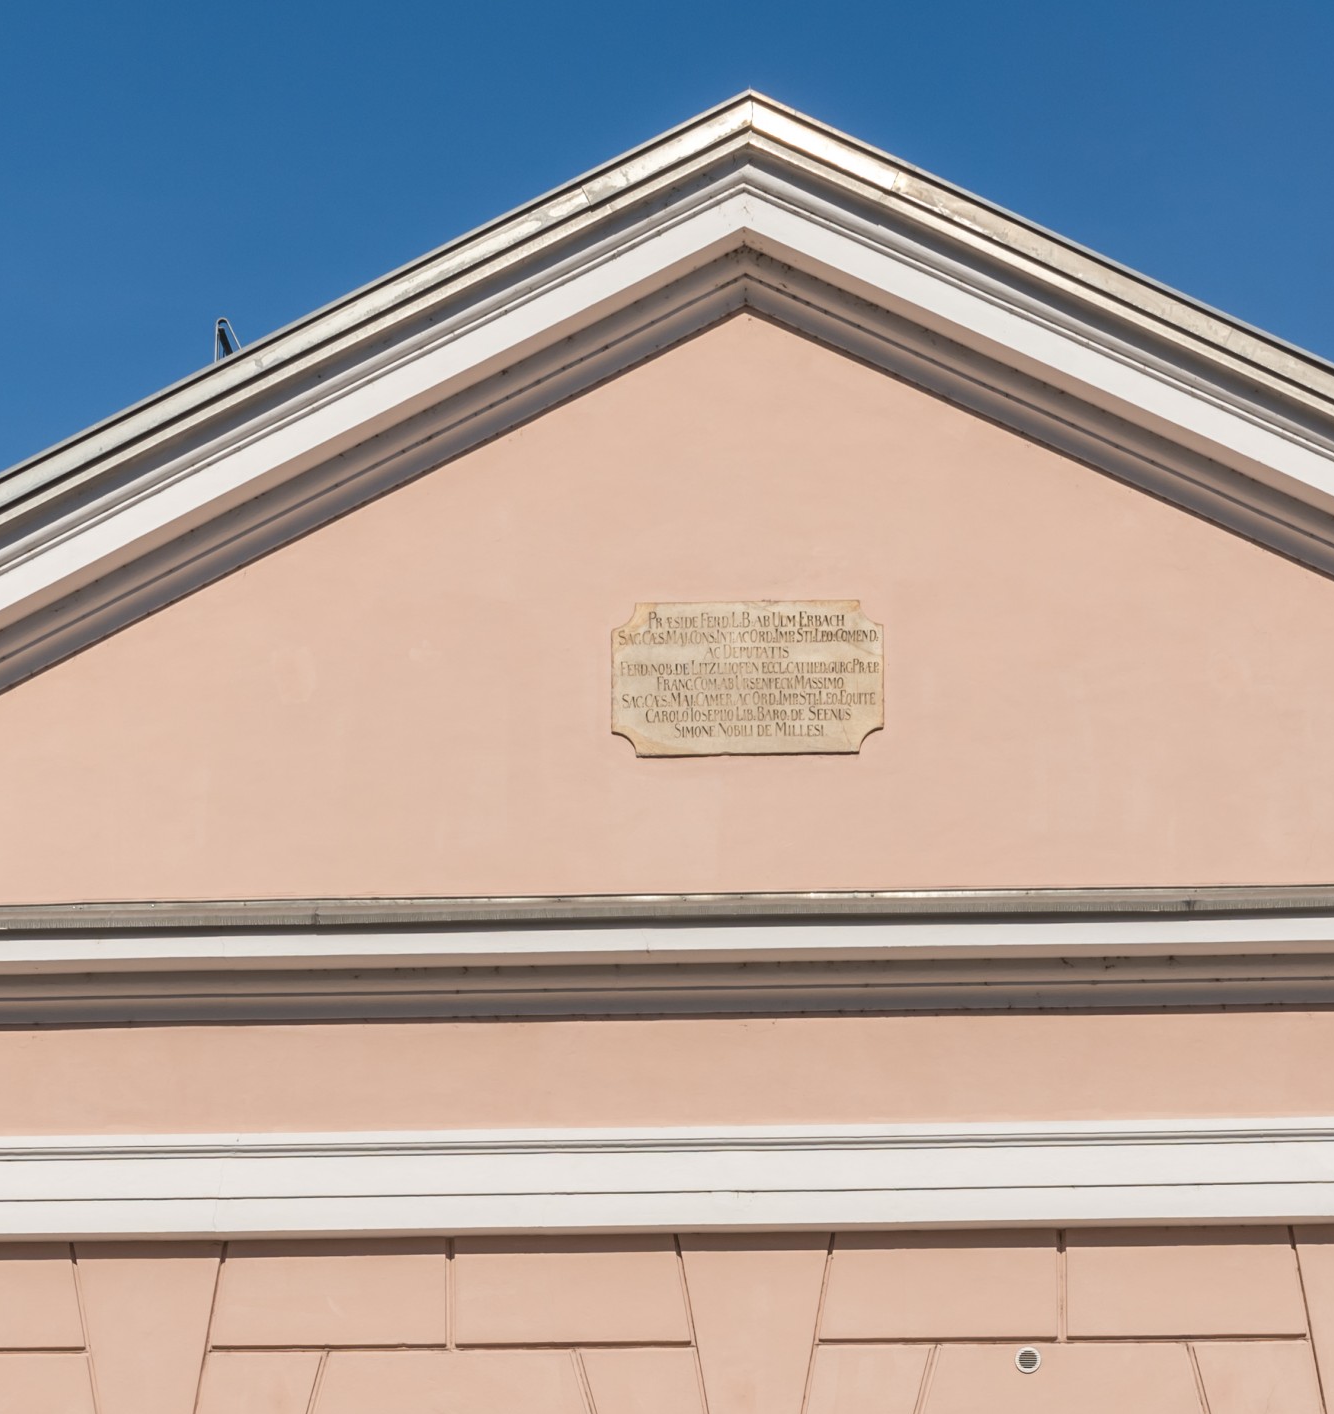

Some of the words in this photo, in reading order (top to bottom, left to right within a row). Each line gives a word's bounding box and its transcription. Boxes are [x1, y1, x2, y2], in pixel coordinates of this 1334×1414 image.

[772, 611, 795, 628] ULM
[799, 610, 844, 628] ERBACH
[723, 644, 789, 659] DEPUTATIS
[794, 674, 844, 690] MASSIMO
[645, 708, 689, 723] CAROLO
[674, 723, 716, 738] SIMONE
[717, 722, 753, 737] NOBILI
[757, 725, 771, 737] DE
